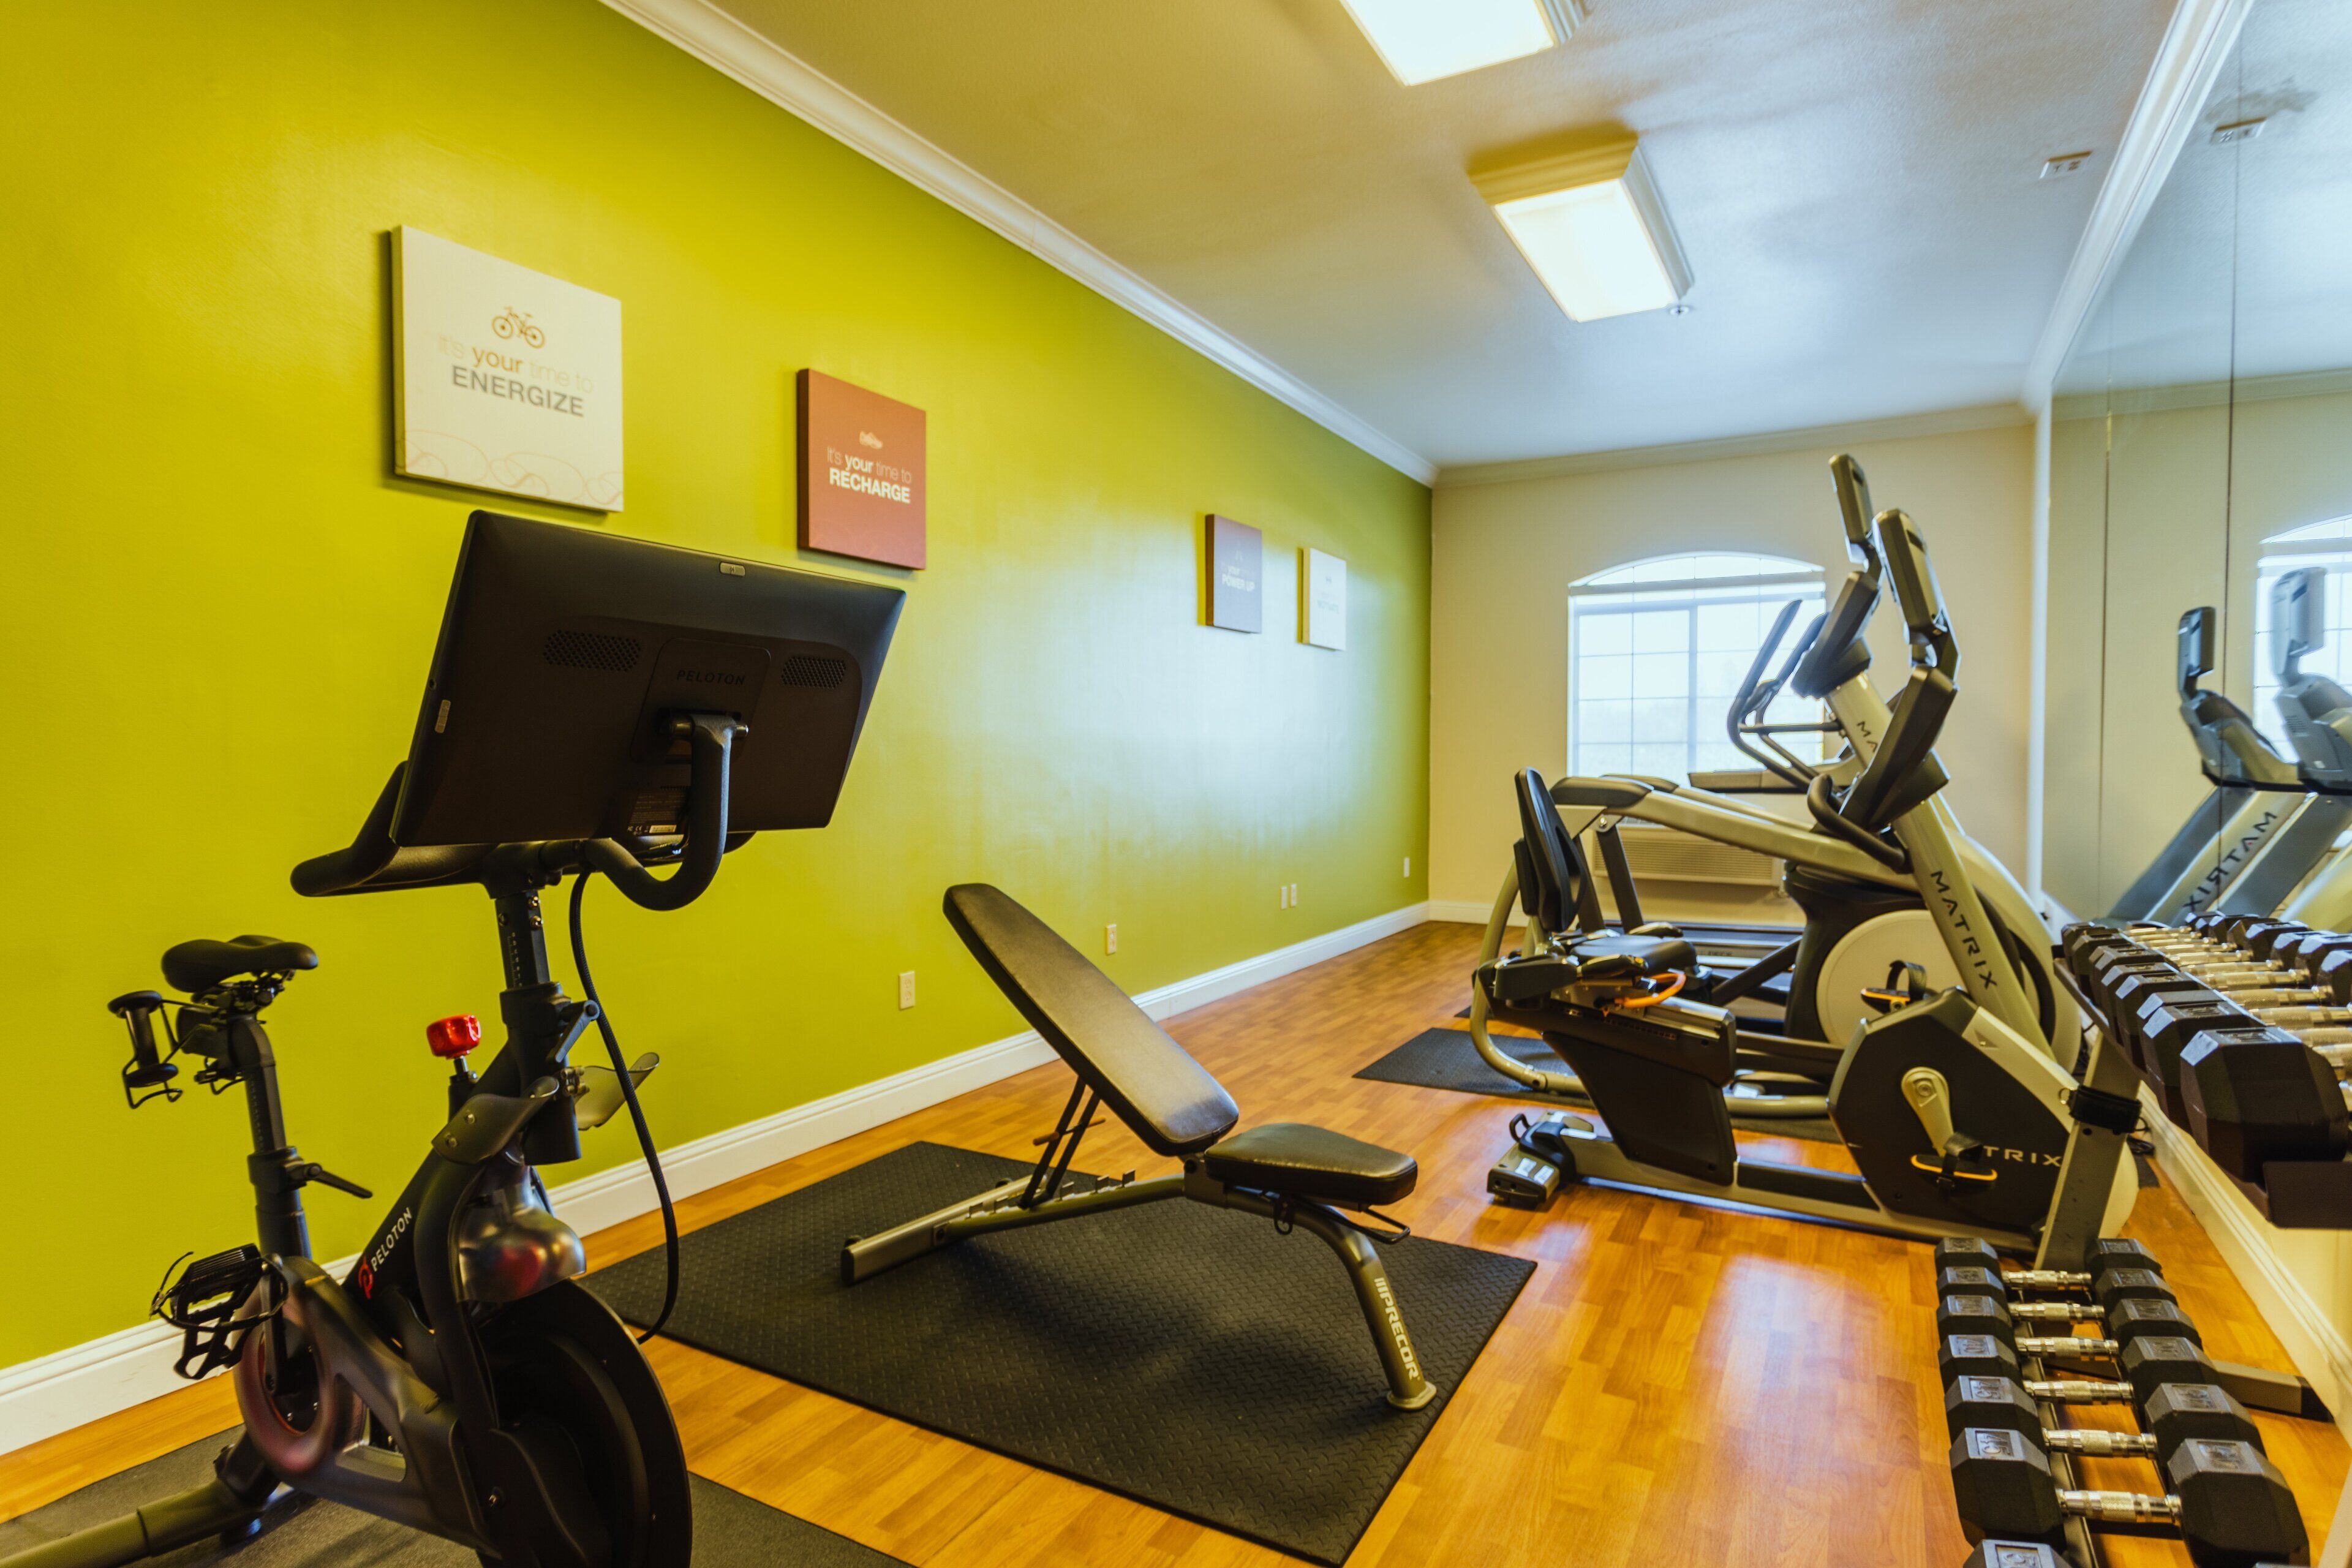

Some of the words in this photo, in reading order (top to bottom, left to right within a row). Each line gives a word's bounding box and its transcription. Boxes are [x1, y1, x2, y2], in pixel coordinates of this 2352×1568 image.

[451, 365, 584, 418] ENERGIZE
[472, 347, 522, 372] your
[529, 359, 571, 387] time
[576, 371, 594, 394] to
[829, 467, 911, 504] RECHARGE
[845, 453, 873, 473] your
[876, 461, 899, 481] time
[901, 468, 911, 484] to
[677, 669, 745, 685] PELOTON
[1931, 871, 1997, 990] MATRIX
[1983, 1145, 2062, 1167] TRIX
[371, 1207, 412, 1273] PELOTON
[1379, 1289, 1419, 1381] PRECOR
